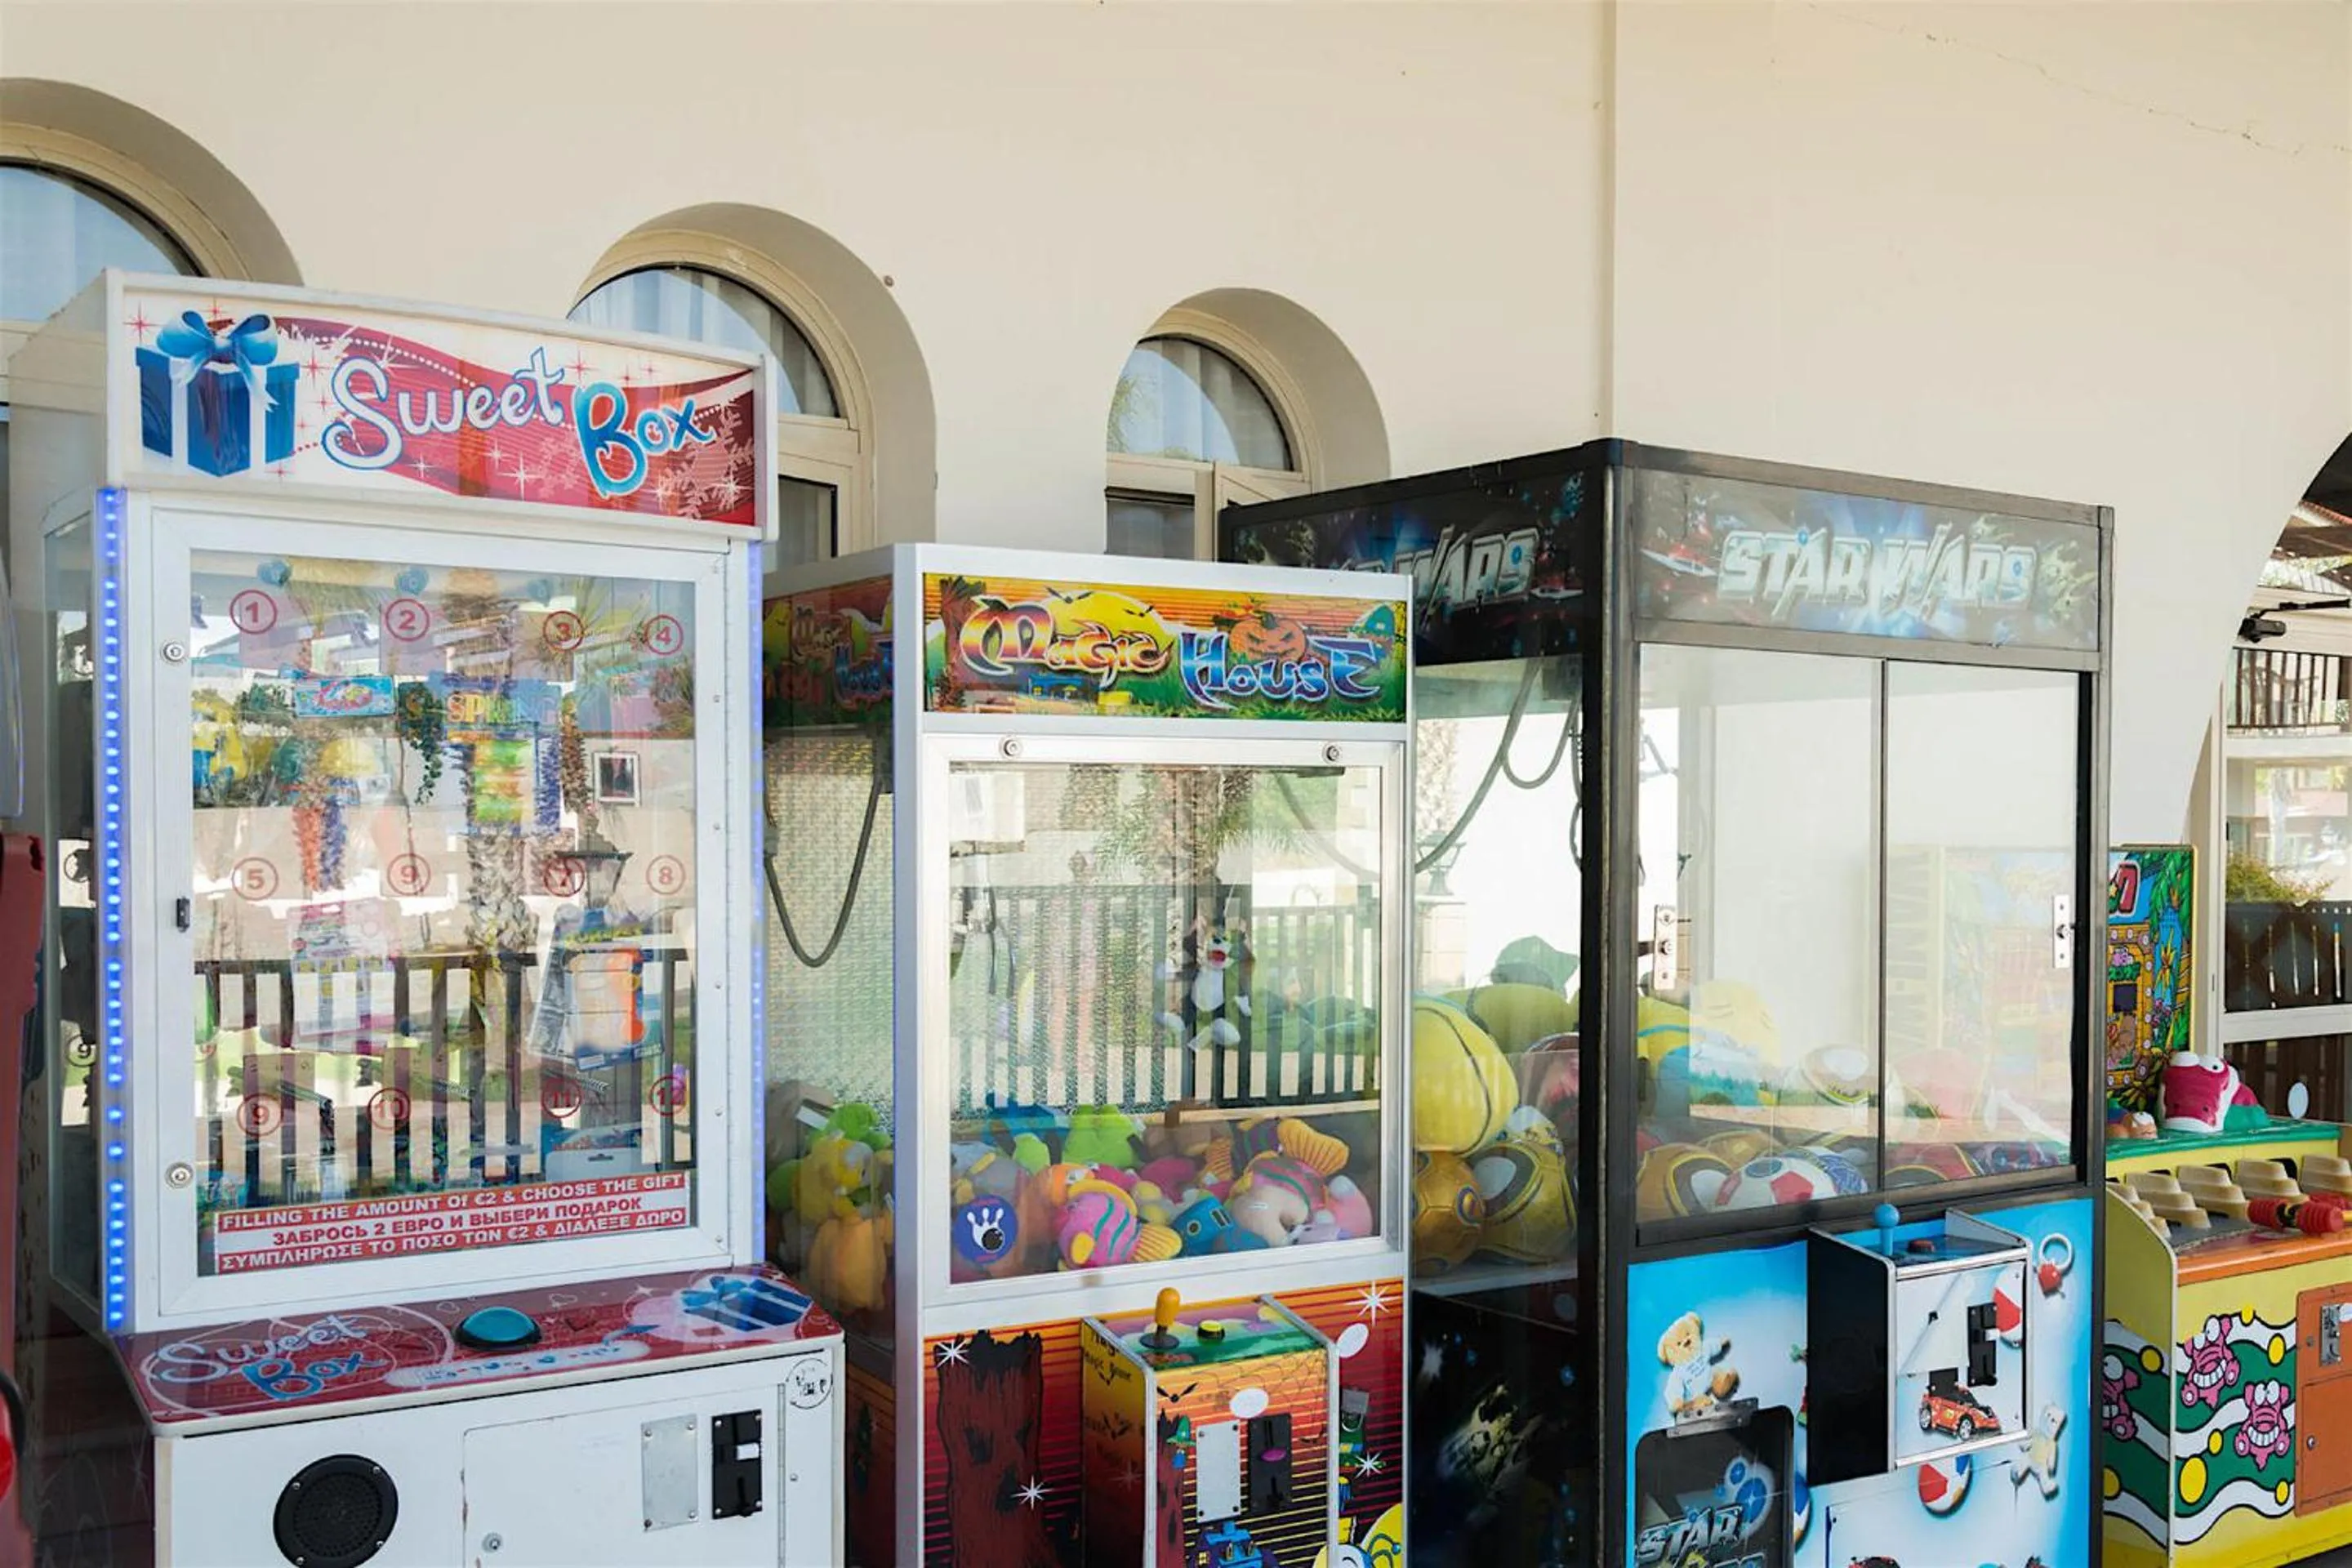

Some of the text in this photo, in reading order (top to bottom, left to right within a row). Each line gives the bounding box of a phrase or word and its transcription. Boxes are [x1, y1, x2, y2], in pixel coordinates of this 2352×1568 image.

[321, 345, 717, 501] Sweet Box
[1717, 521, 2038, 621] STAR WARS
[222, 1212, 303, 1229] FILLING
[309, 1205, 350, 1221] THE
[355, 1196, 441, 1218] AMOUNT
[474, 1192, 497, 1205] €2
[502, 1191, 515, 1203] &
[522, 1182, 596, 1201] CHOOSE
[599, 1178, 638, 1193] THE
[643, 1174, 684, 1189] GIFT
[273, 1196, 643, 1245] ЗАБРОСЬ 2 ЕВРО И ВЫБЕРИ ПОДАРОК
[507, 1227, 529, 1240] €2
[535, 1225, 548, 1237] &
[156, 1314, 368, 1383] Sweet
[241, 1351, 390, 1402] Box
[1636, 1504, 1744, 1567] STAR
